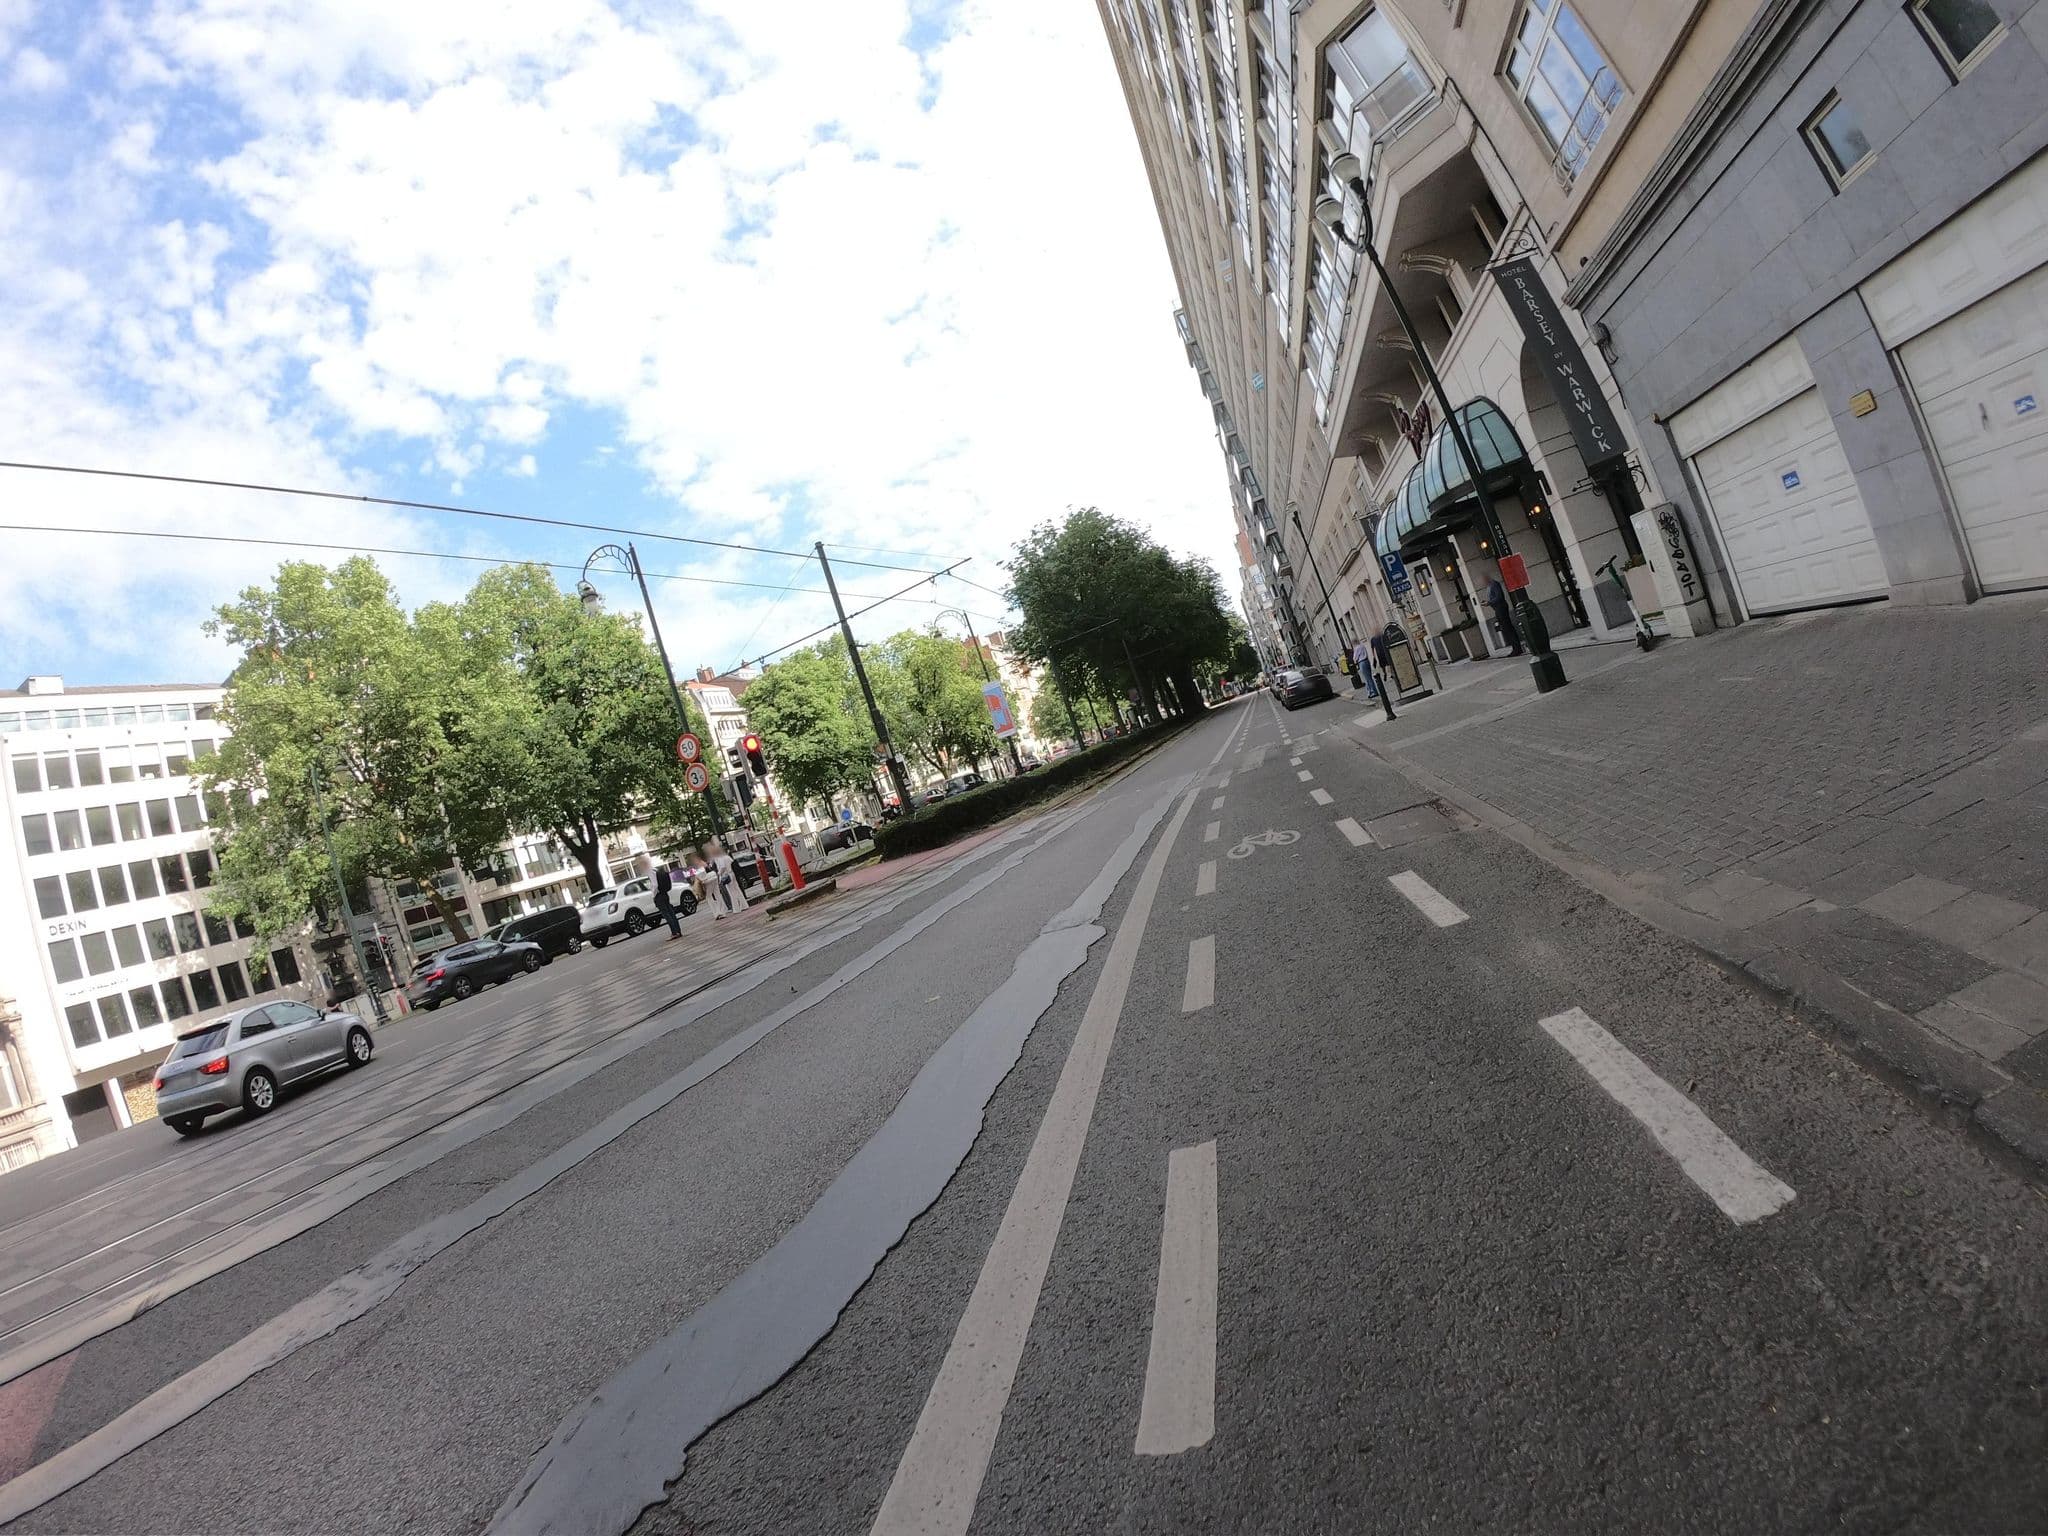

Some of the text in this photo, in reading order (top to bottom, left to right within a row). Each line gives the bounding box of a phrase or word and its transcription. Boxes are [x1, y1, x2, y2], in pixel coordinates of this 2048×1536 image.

[1501, 266, 1528, 278] HOTEL
[1514, 277, 1556, 346] BARSEY
[1554, 351, 1563, 359] BY
[1556, 362, 1612, 453] WARWICK
[1384, 554, 1396, 571] P
[681, 740, 694, 753] 50
[48, 919, 87, 936] DEXIN
